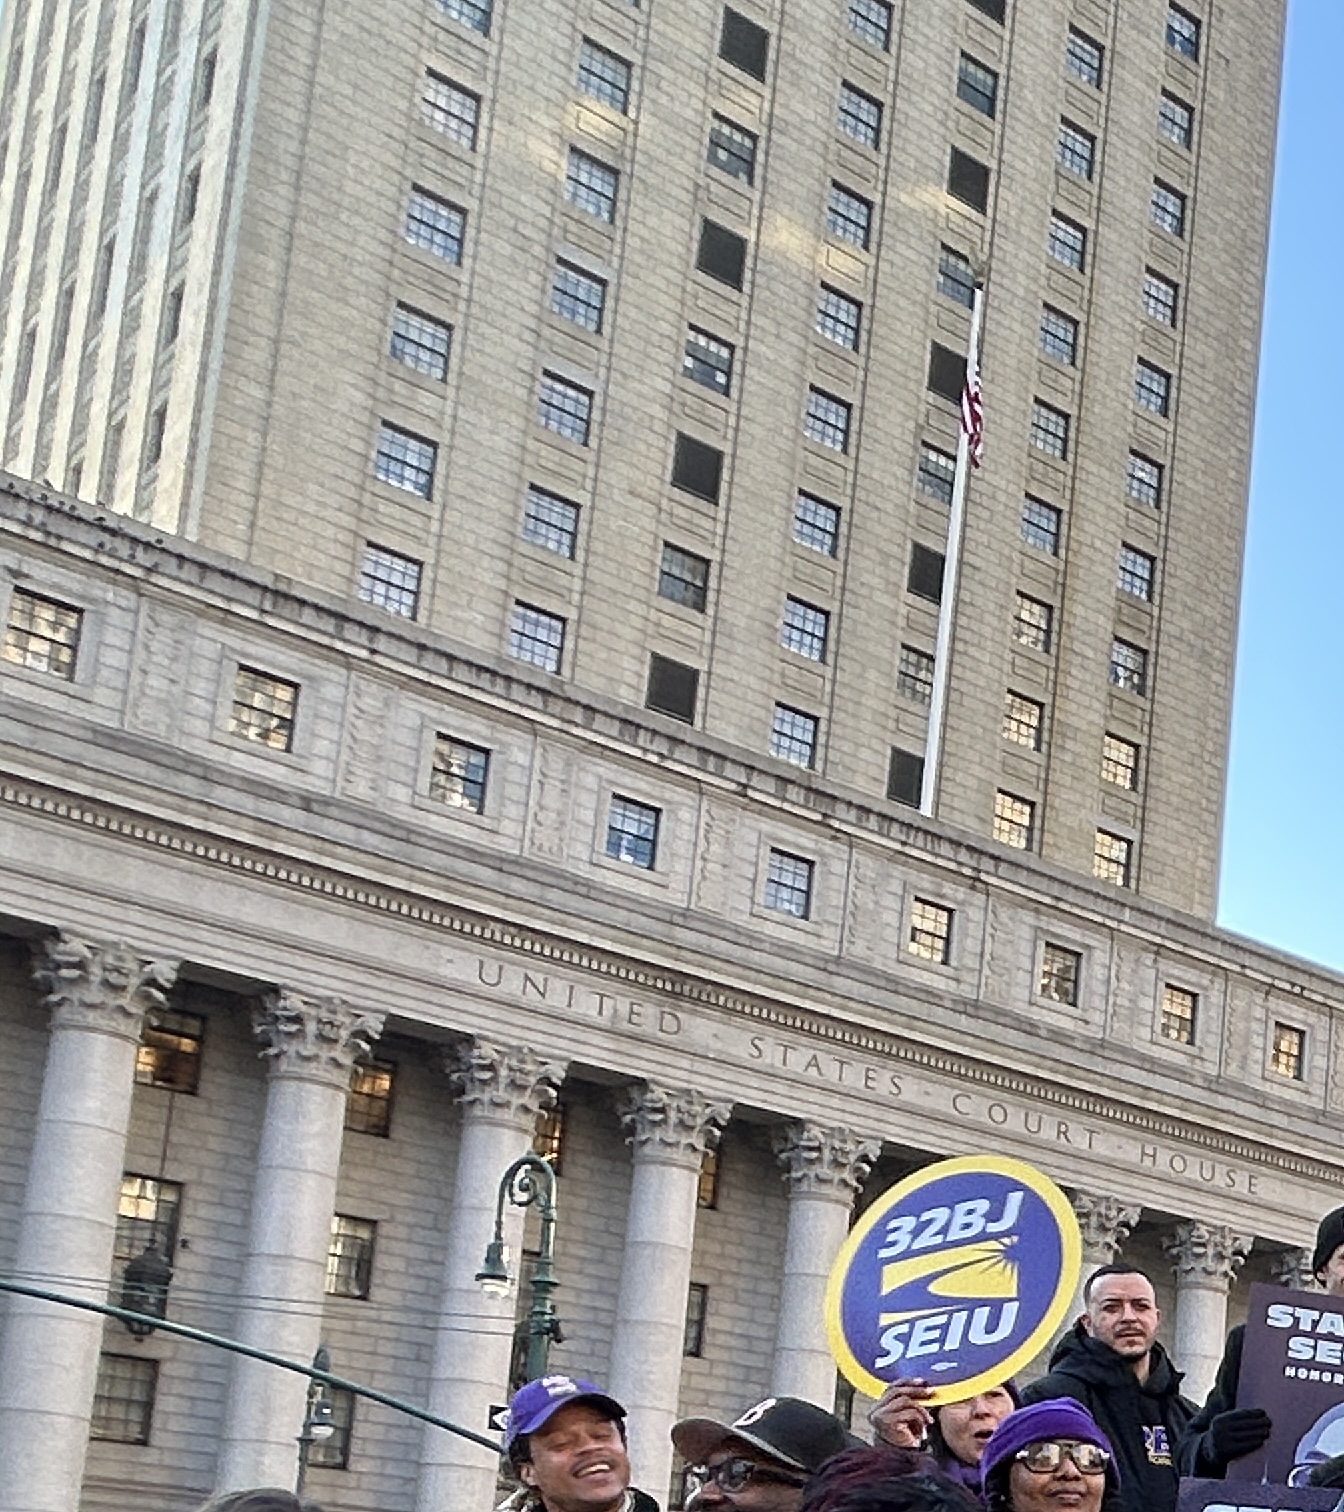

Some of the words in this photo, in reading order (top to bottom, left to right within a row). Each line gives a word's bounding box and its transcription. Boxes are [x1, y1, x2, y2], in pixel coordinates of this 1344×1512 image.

[478, 958, 682, 1036] UNITED
[749, 1036, 904, 1096] STATES
[952, 1093, 1102, 1150] COURT
[1140, 1143, 1258, 1195] HOUSE
[877, 1190, 1024, 1258] 32BJ
[874, 1301, 1020, 1369] SEIU
[1283, 1366, 1344, 1385] HONOR
